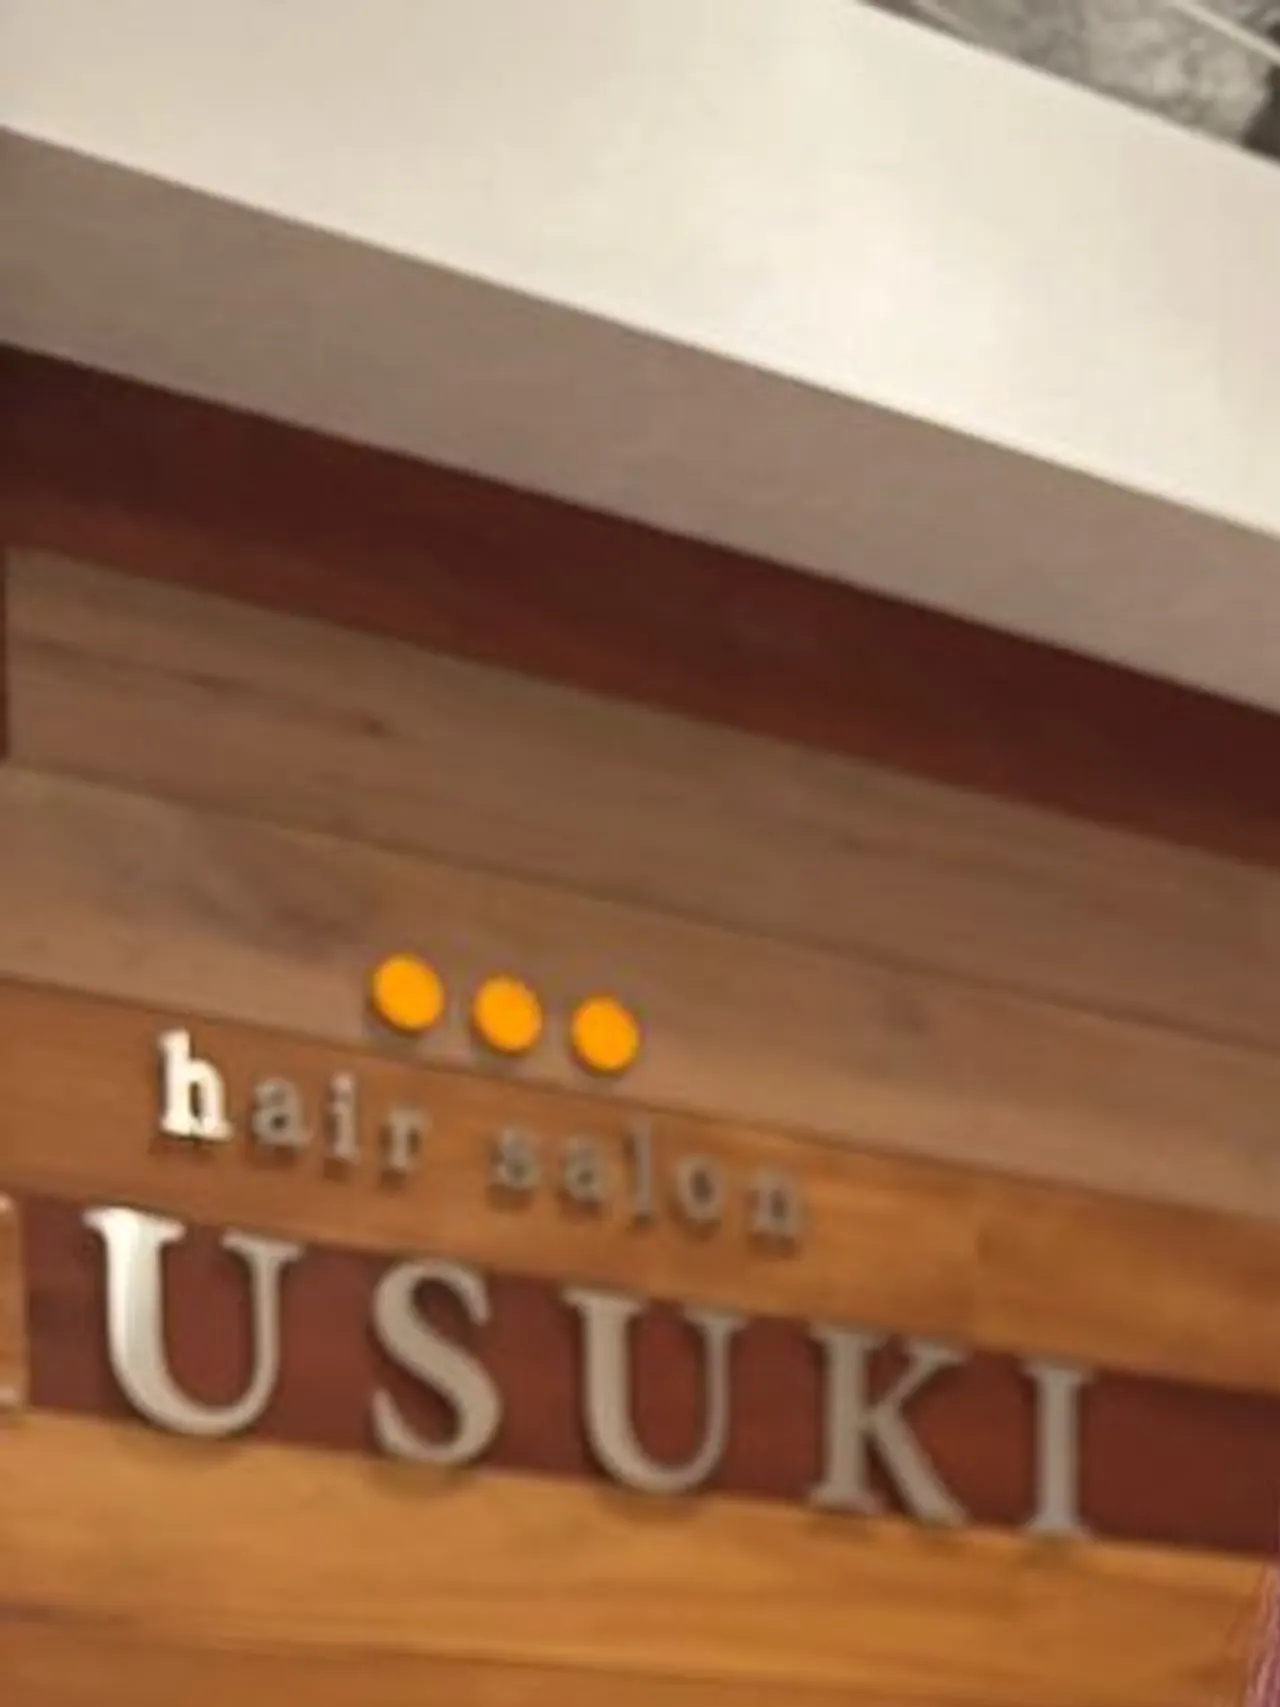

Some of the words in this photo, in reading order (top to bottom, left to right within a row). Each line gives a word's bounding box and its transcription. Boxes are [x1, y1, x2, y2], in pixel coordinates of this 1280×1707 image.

[156, 1029, 434, 1175] hair
[491, 1118, 807, 1240] salon
[0, 1193, 1096, 1539] USUKI
